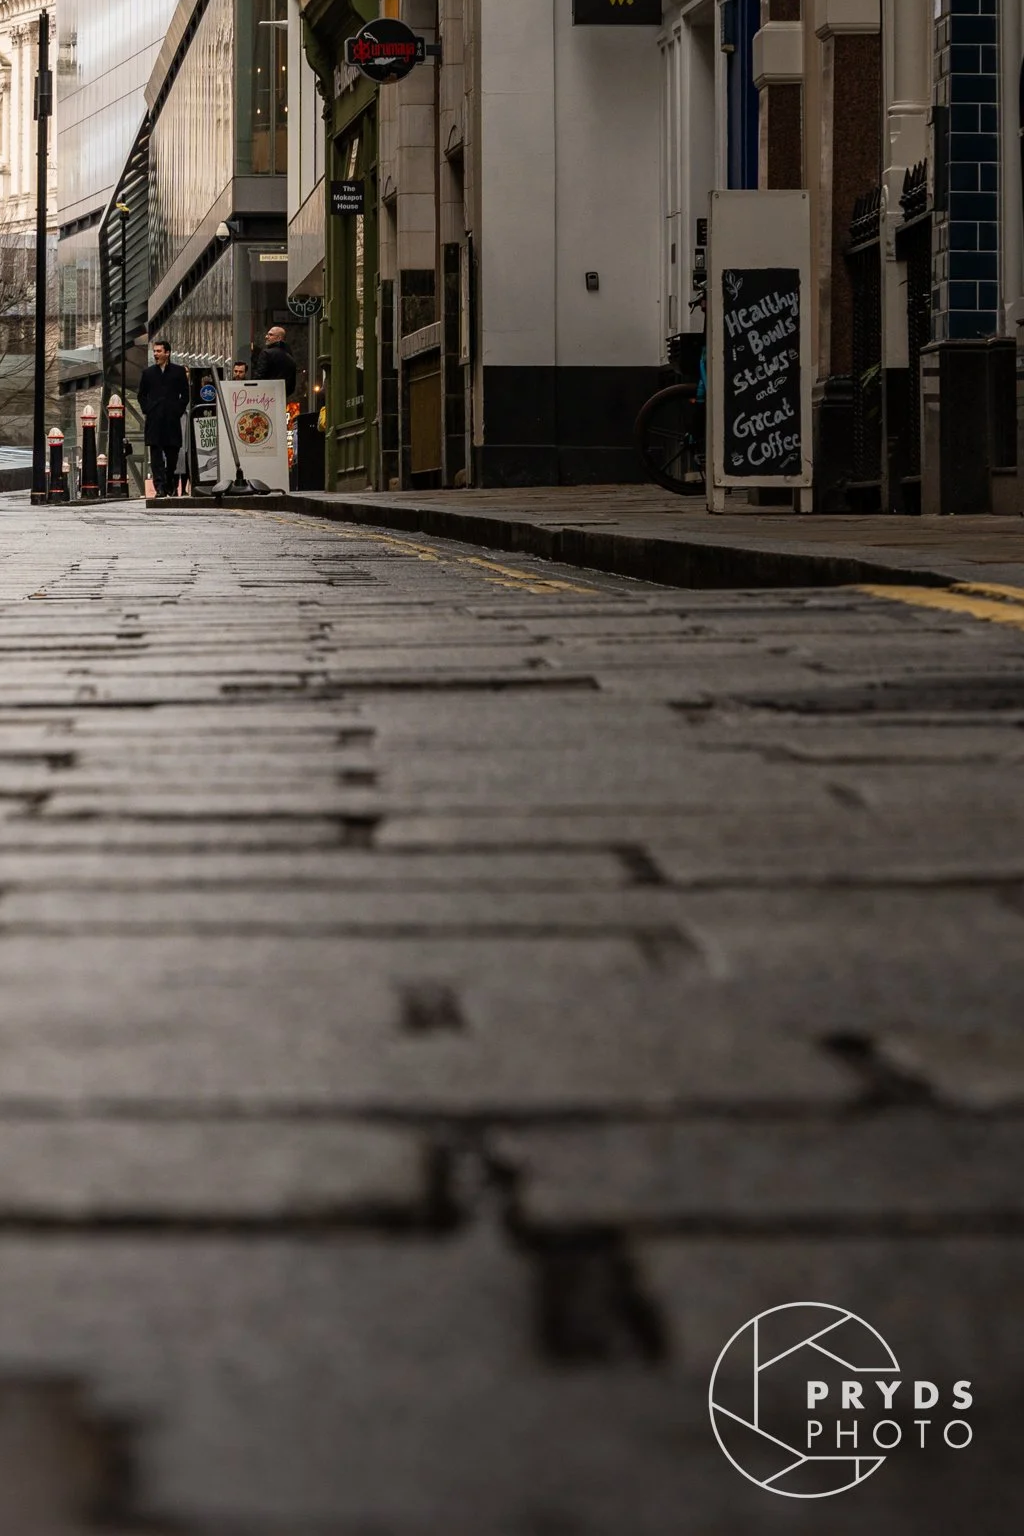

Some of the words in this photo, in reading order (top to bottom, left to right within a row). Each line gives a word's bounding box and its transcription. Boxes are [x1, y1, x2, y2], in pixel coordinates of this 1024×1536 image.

[333, 194, 363, 202] Mokapot
[725, 291, 799, 337] Healthy
[747, 317, 797, 355] Bowls
[232, 389, 276, 413] Porridge
[755, 380, 777, 401] and
[199, 419, 217, 429] SAND
[732, 397, 795, 438] Great
[747, 430, 801, 466] Coffee
